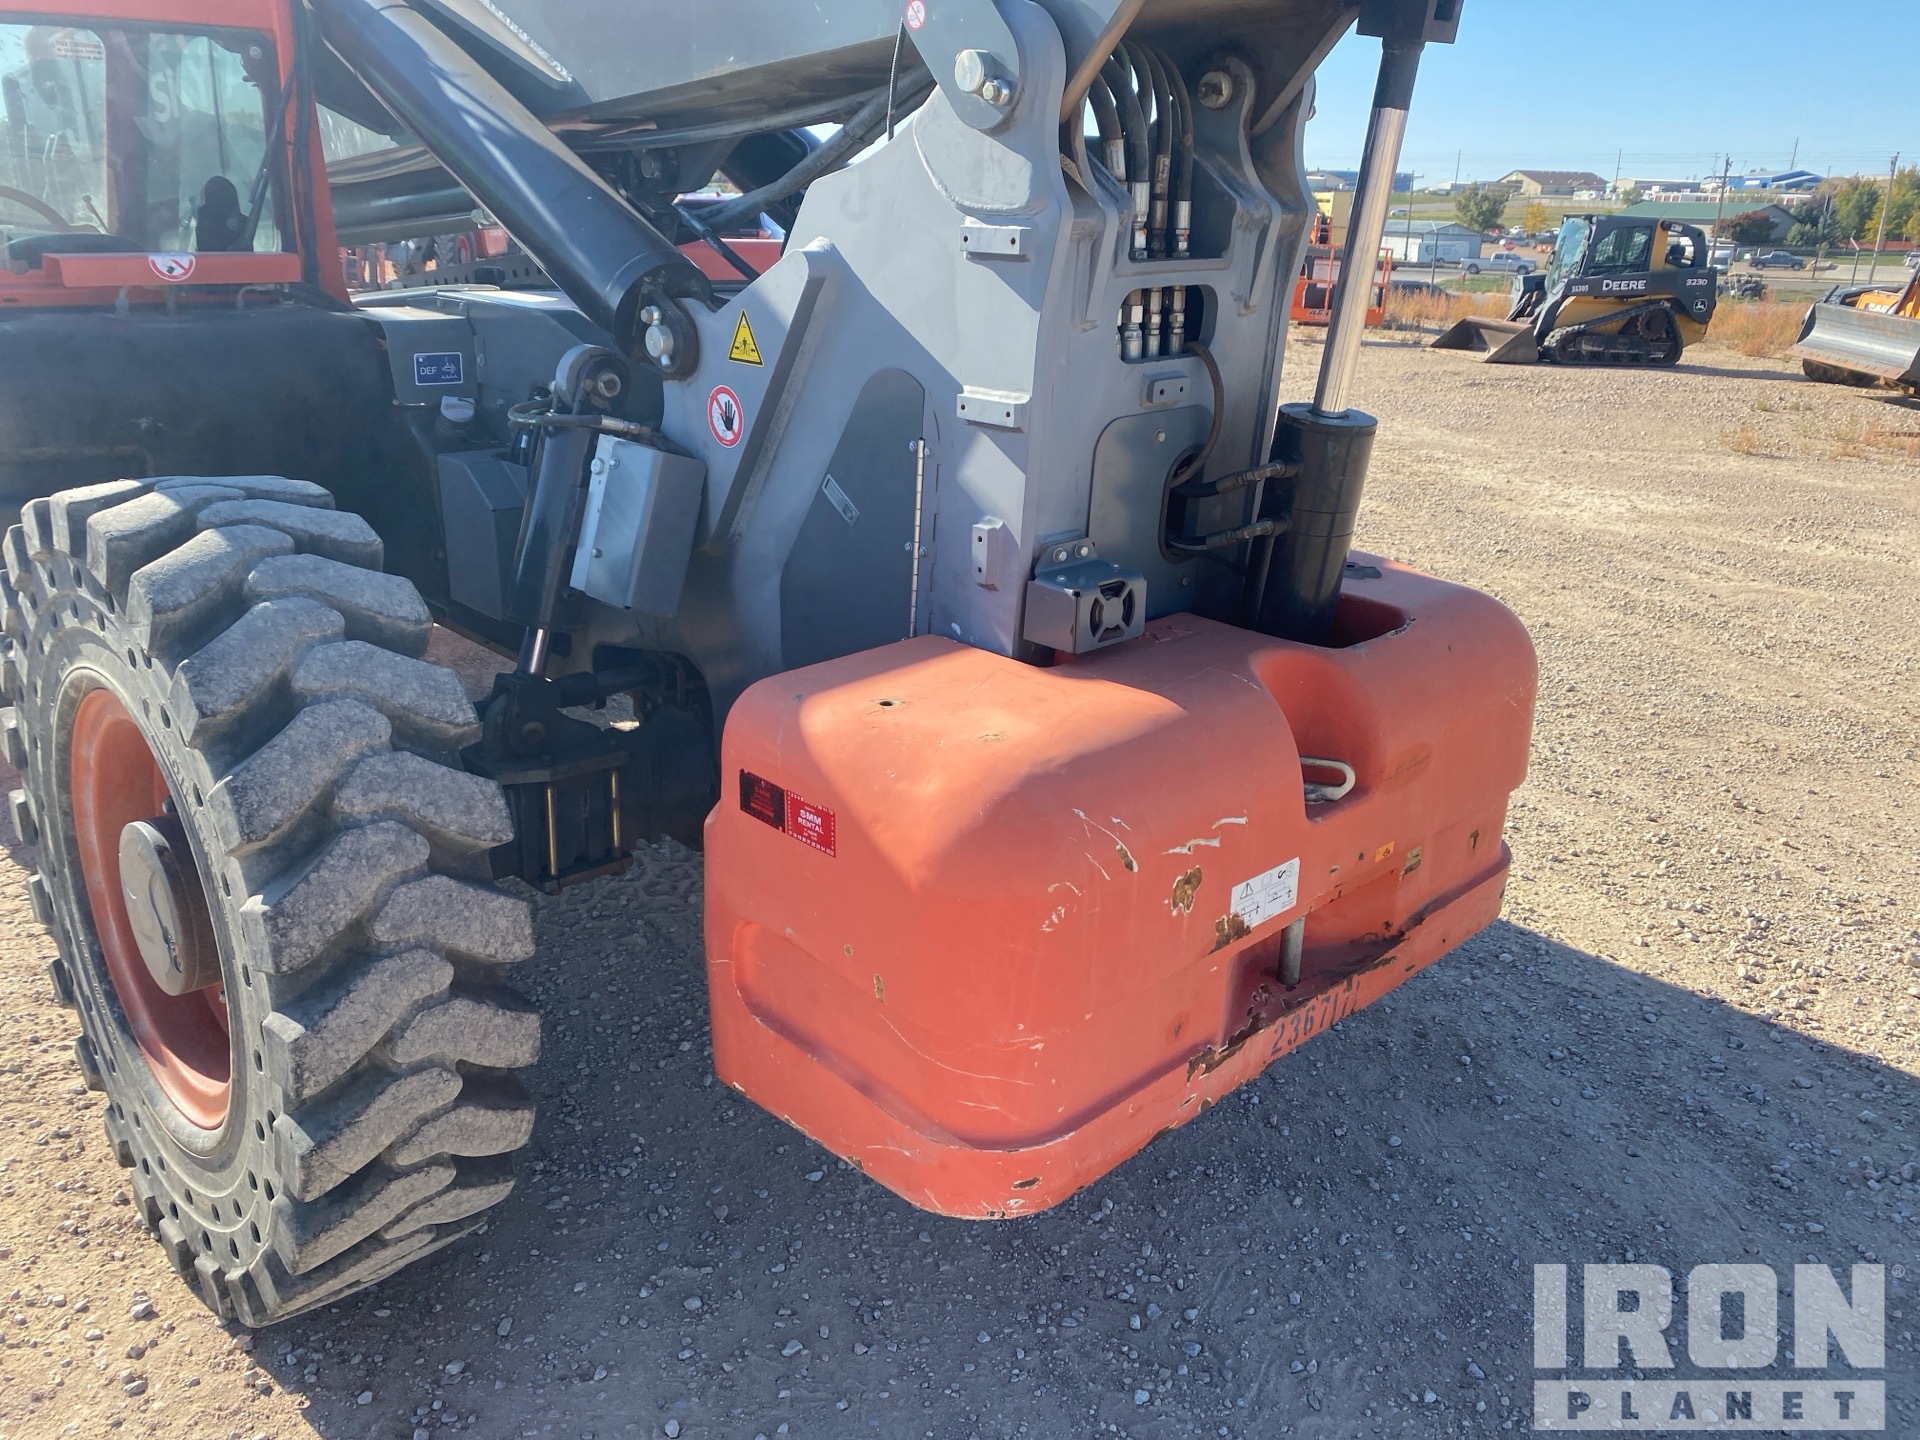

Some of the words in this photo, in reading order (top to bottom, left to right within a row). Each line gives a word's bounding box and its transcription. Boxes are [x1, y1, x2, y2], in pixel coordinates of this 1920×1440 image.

[1602, 279, 1647, 291] DEERE
[1686, 278, 1708, 286] 323D
[419, 367, 437, 375] DEF
[799, 809, 822, 826] SMM
[797, 816, 825, 835] RENTAL
